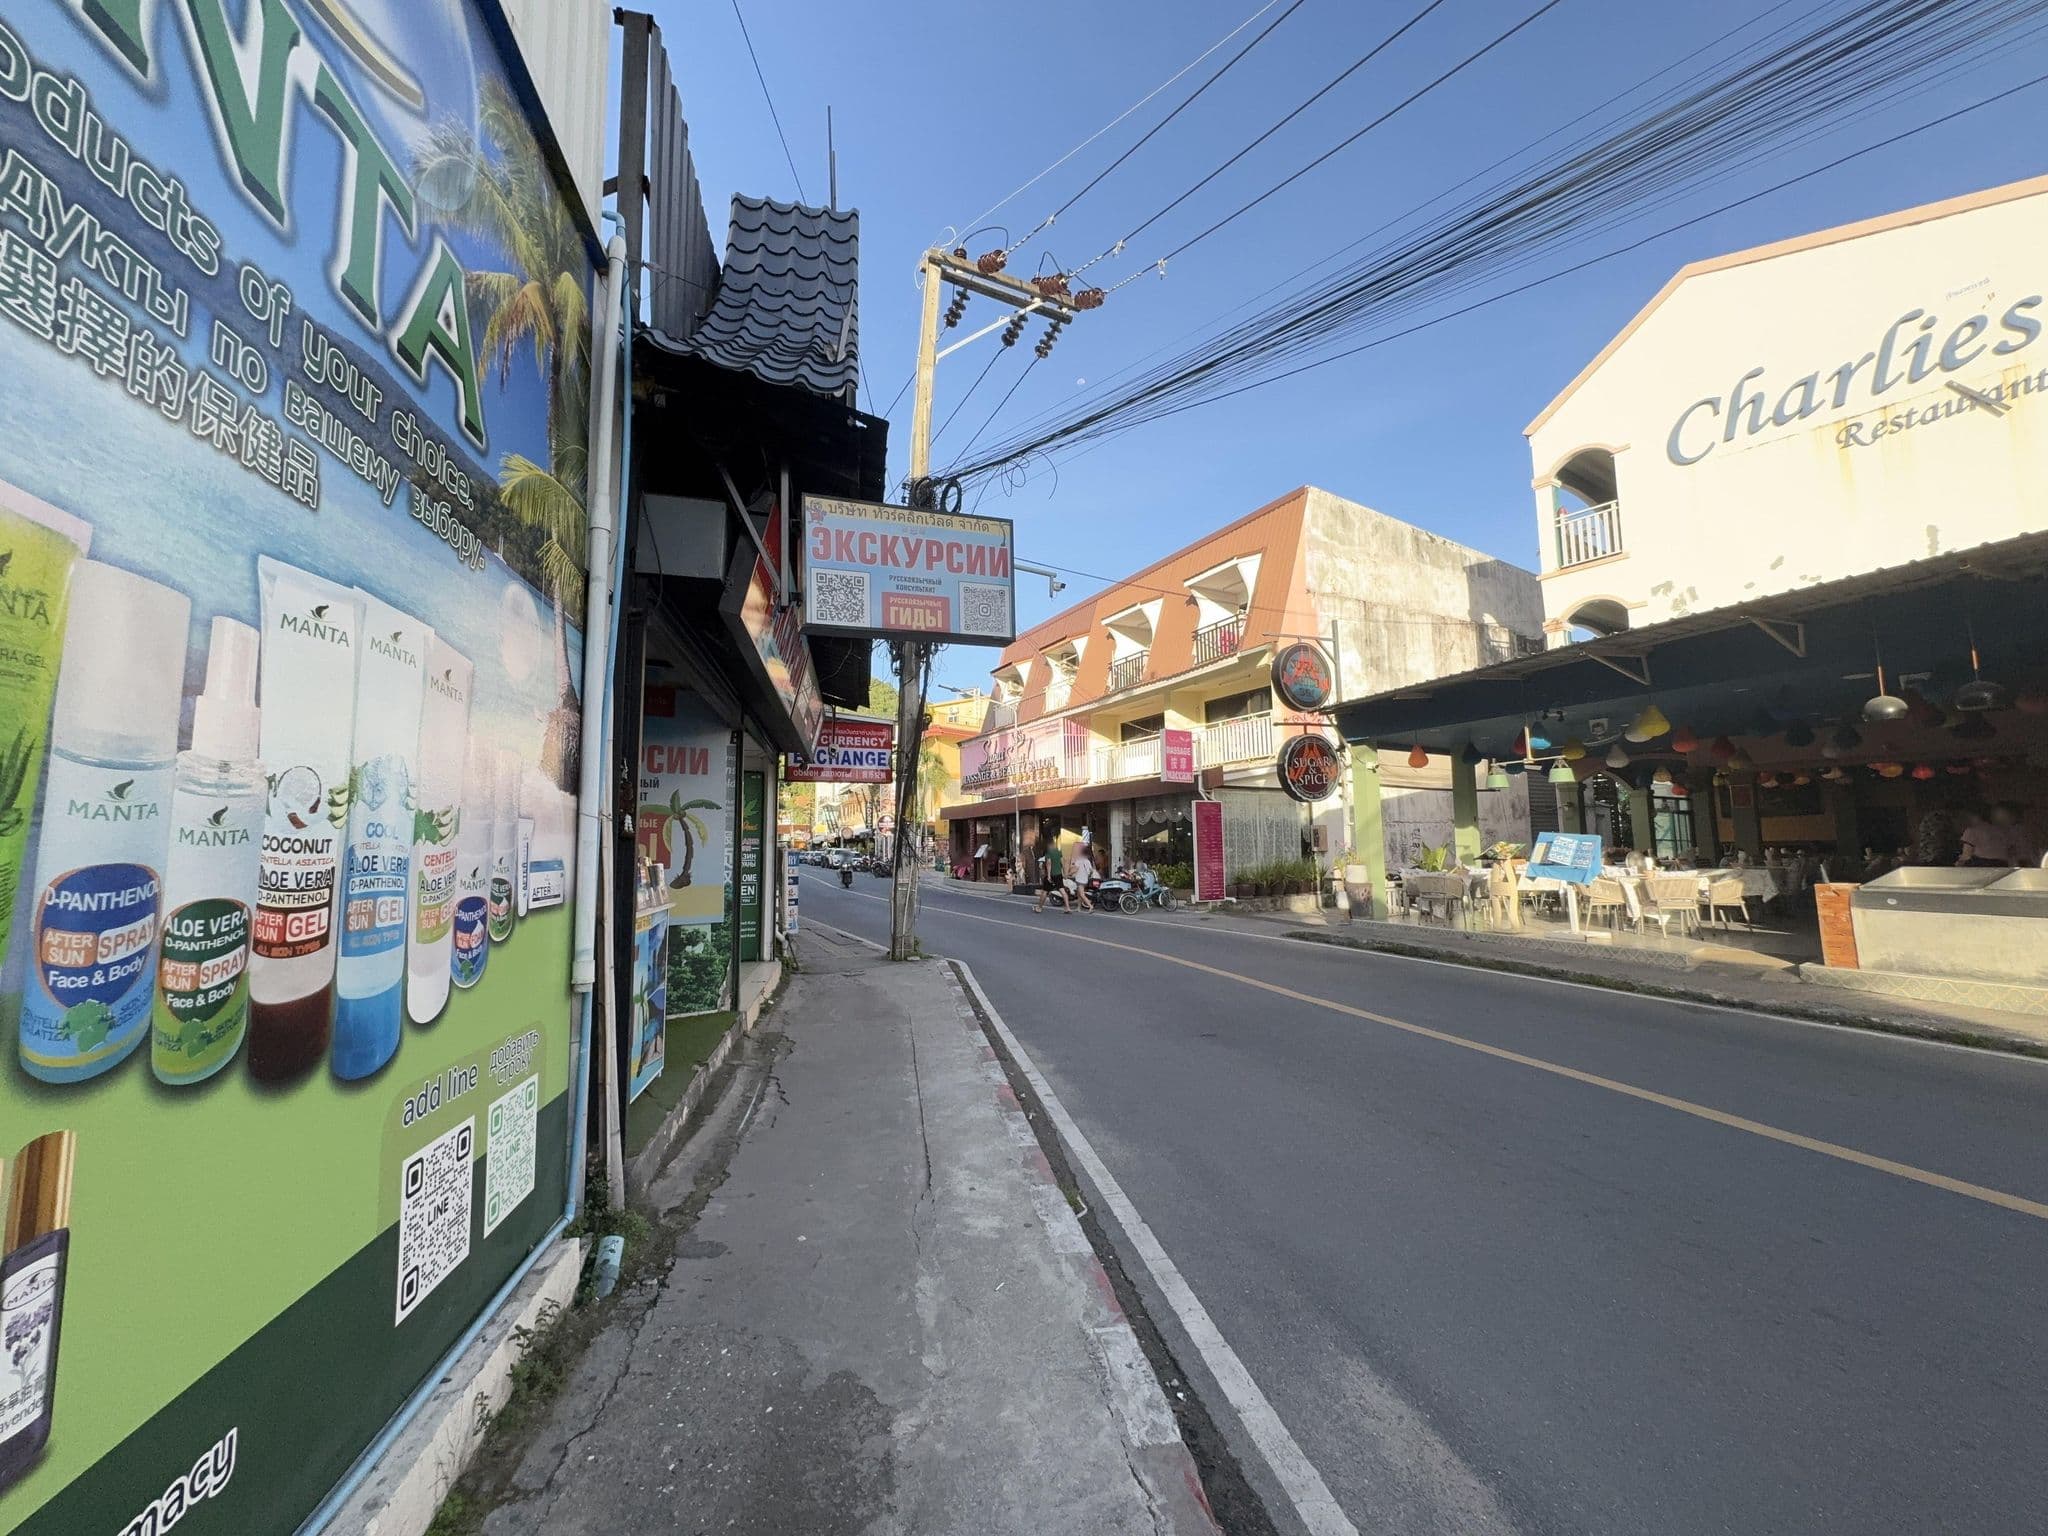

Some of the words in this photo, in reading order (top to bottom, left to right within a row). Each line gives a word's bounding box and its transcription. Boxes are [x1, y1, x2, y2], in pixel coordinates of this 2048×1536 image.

[239, 264, 292, 348] of
[302, 318, 383, 424] your
[390, 409, 475, 512] choice.
[212, 318, 268, 394] по
[283, 378, 401, 507] вашему
[811, 526, 1010, 579] ЭКСКУРСИИ
[889, 606, 943, 630] ГИДЫ
[280, 613, 350, 648] MANTA
[370, 636, 417, 668] MANTA
[430, 676, 464, 703] MANTA
[820, 735, 886, 747] CURRENCY
[640, 744, 709, 776] СИИ
[793, 748, 887, 767] ECHANGE
[1294, 755, 1331, 770] SUGAR
[1298, 773, 1329, 787] SPICE
[1308, 766, 1319, 776] &
[67, 799, 160, 822] MANTA
[179, 826, 251, 847] MANTA
[262, 834, 333, 855] COCONUT
[350, 876, 405, 892] D-PANTHENOL
[258, 891, 328, 905] D-PANTHENOL
[164, 915, 205, 939] ALOE
[208, 907, 249, 935] VERA
[348, 914, 370, 930] SUN
[377, 898, 403, 924] GEL
[256, 926, 279, 943] SUN
[288, 912, 327, 938] GEL
[45, 932, 93, 949] AFTER
[99, 921, 155, 961] SPRAY
[165, 928, 247, 952] D-PANTHENOL
[49, 948, 85, 965] SUN
[200, 950, 246, 985] SPRAY
[48, 970, 89, 990] Face
[91, 968, 107, 986] &
[109, 953, 146, 983] Body
[163, 963, 197, 977] AFTER
[166, 976, 191, 991] SUN
[167, 993, 194, 1009] Face
[195, 992, 206, 1007] &
[207, 980, 237, 1002] Body
[488, 1029, 540, 1076] добавить
[496, 1052, 532, 1087] строку
[402, 1075, 442, 1129] add
[446, 1063, 479, 1103] line
[505, 1139, 521, 1162] LINE
[427, 1197, 450, 1227] LINE
